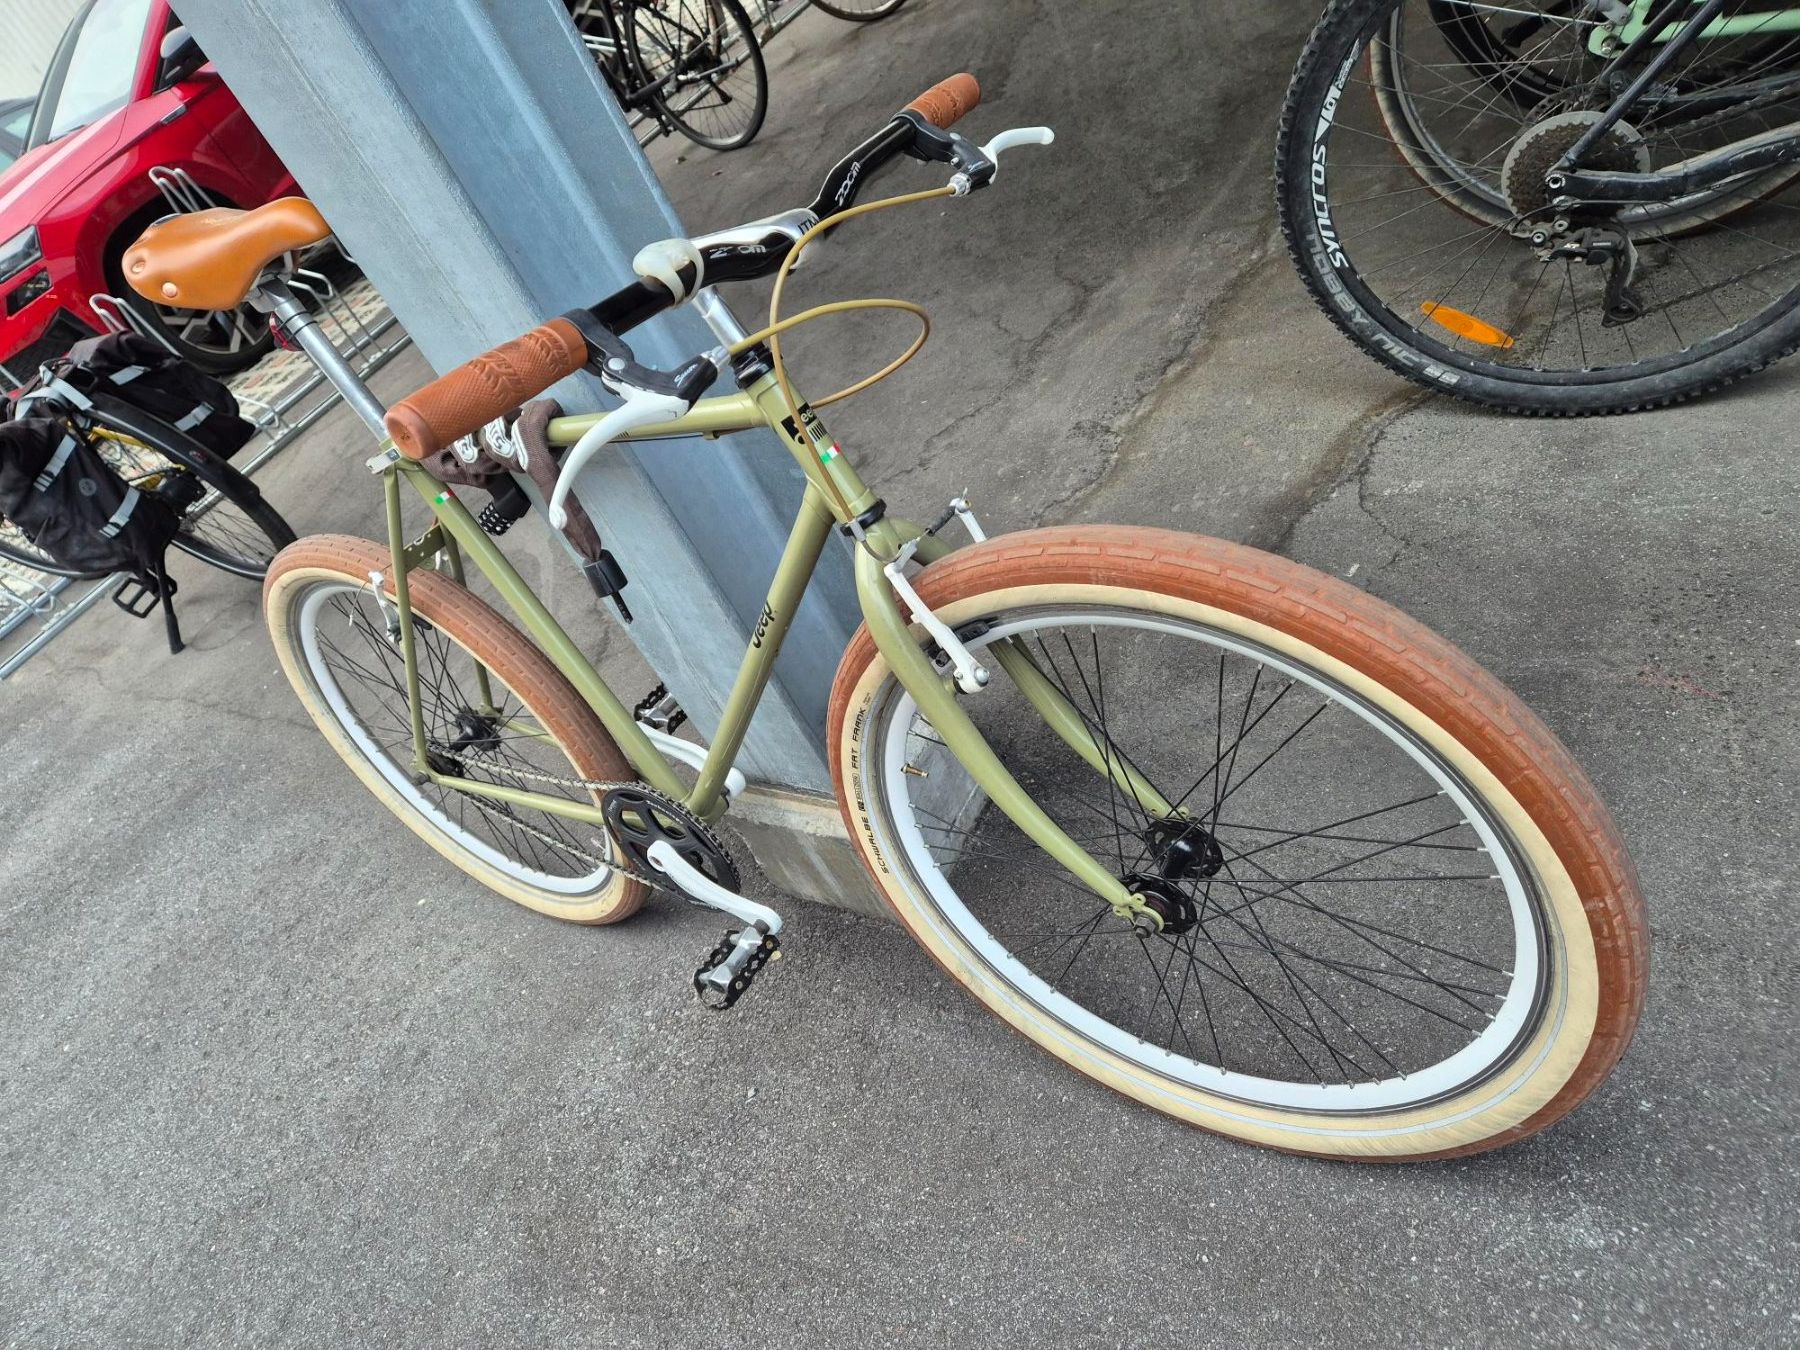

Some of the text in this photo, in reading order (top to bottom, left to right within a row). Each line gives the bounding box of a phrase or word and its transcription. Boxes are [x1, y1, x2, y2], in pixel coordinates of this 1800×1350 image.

[852, 707, 866, 743] FRANK
[851, 747, 859, 770] FAT
[861, 816, 890, 875] SCHWALBE
